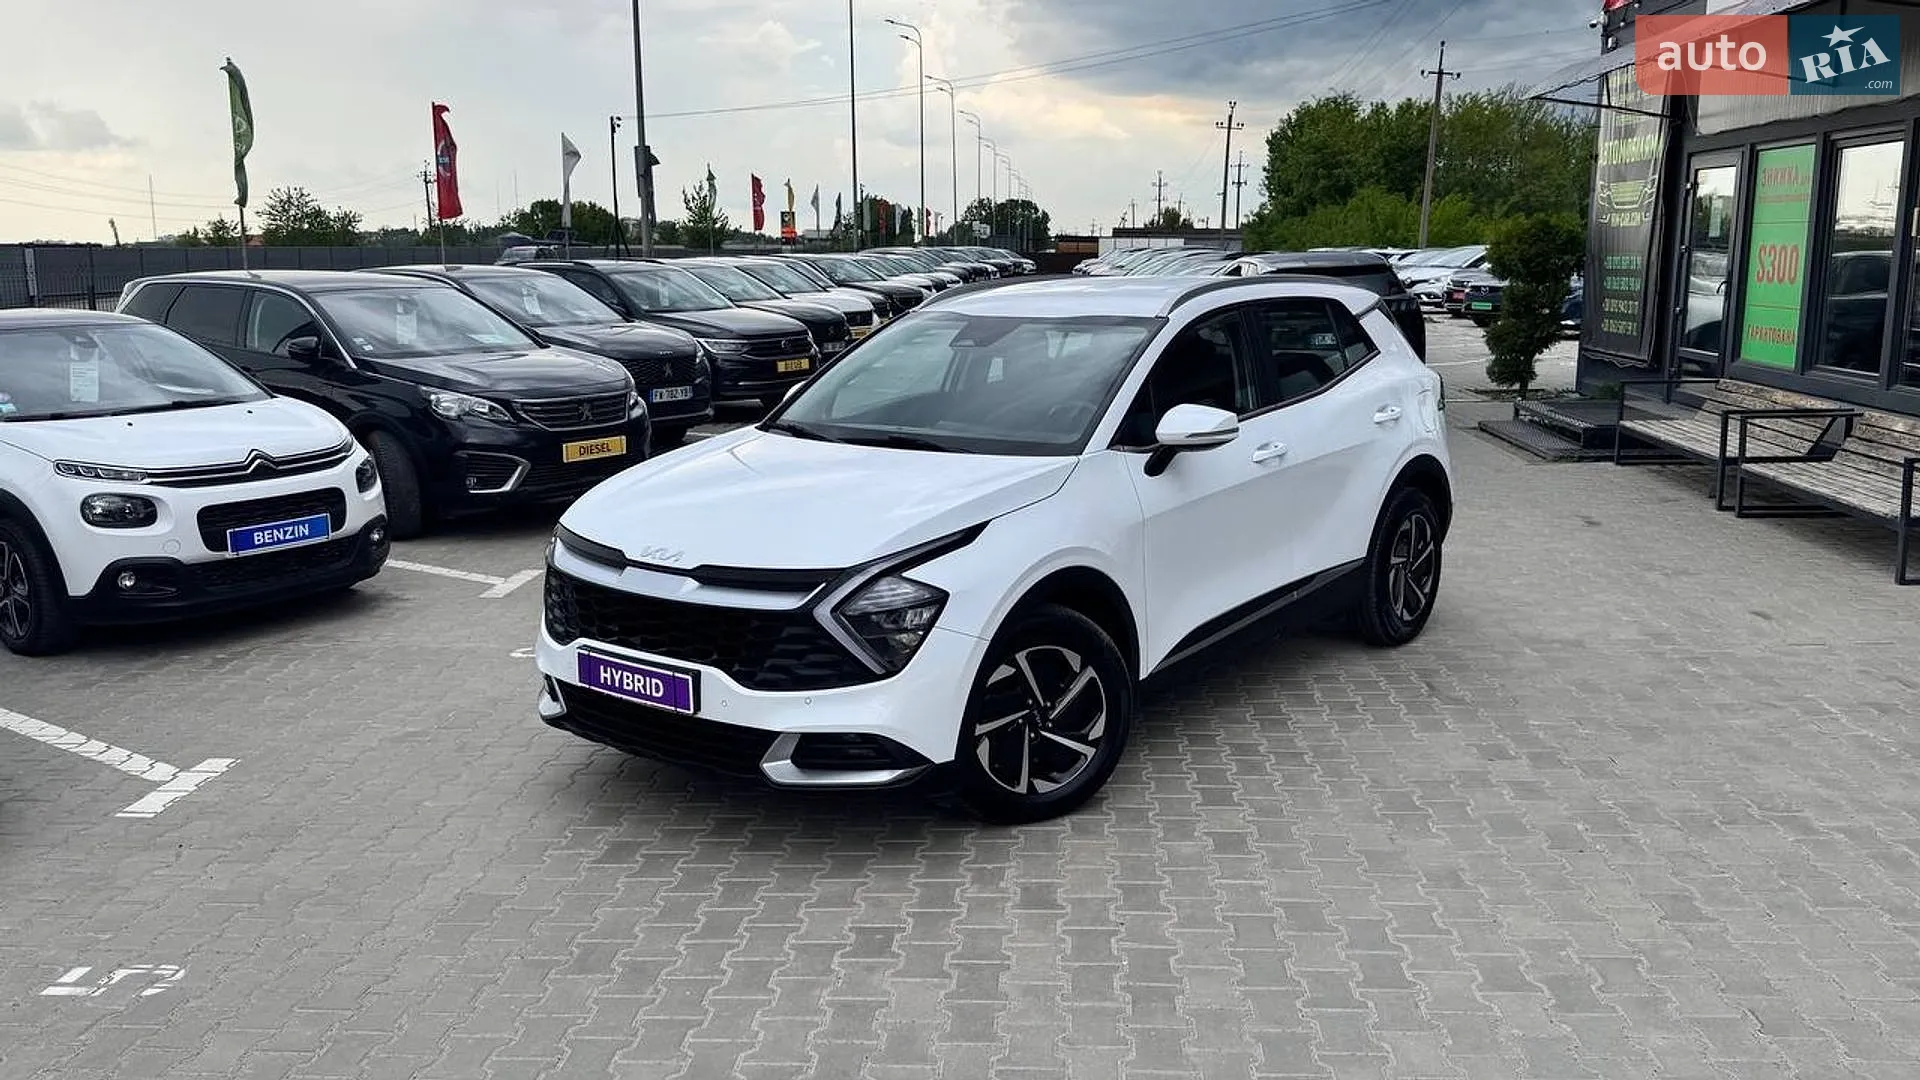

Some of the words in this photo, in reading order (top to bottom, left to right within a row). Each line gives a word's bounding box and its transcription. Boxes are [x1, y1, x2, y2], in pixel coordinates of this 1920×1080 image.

[579, 442, 612, 457] DIESEL
[253, 523, 309, 545] BENZIN
[599, 664, 664, 698] HYBRID
